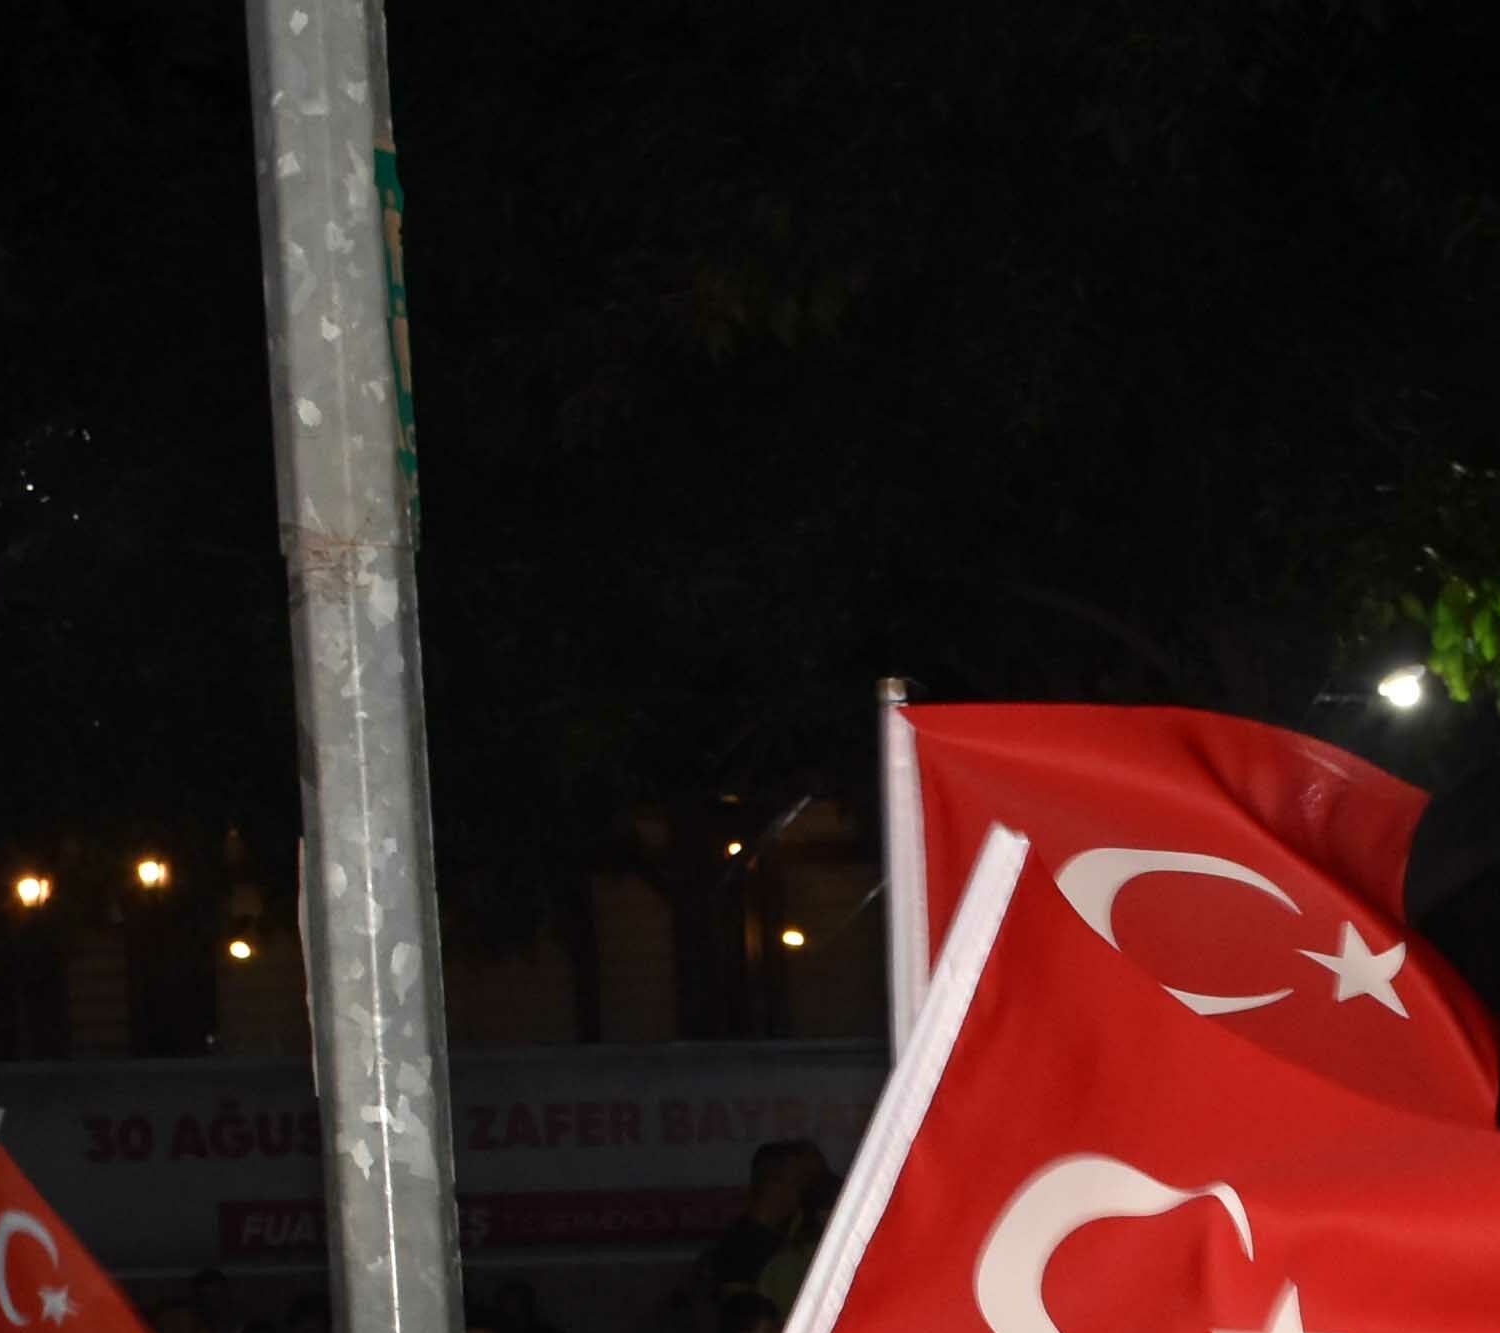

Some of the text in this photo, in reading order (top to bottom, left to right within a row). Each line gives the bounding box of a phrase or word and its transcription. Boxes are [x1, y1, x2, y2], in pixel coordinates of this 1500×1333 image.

[82, 1097, 873, 1164] 30 AĞUS ZAFER BAYRA
[240, 1209, 325, 1246] FUA
